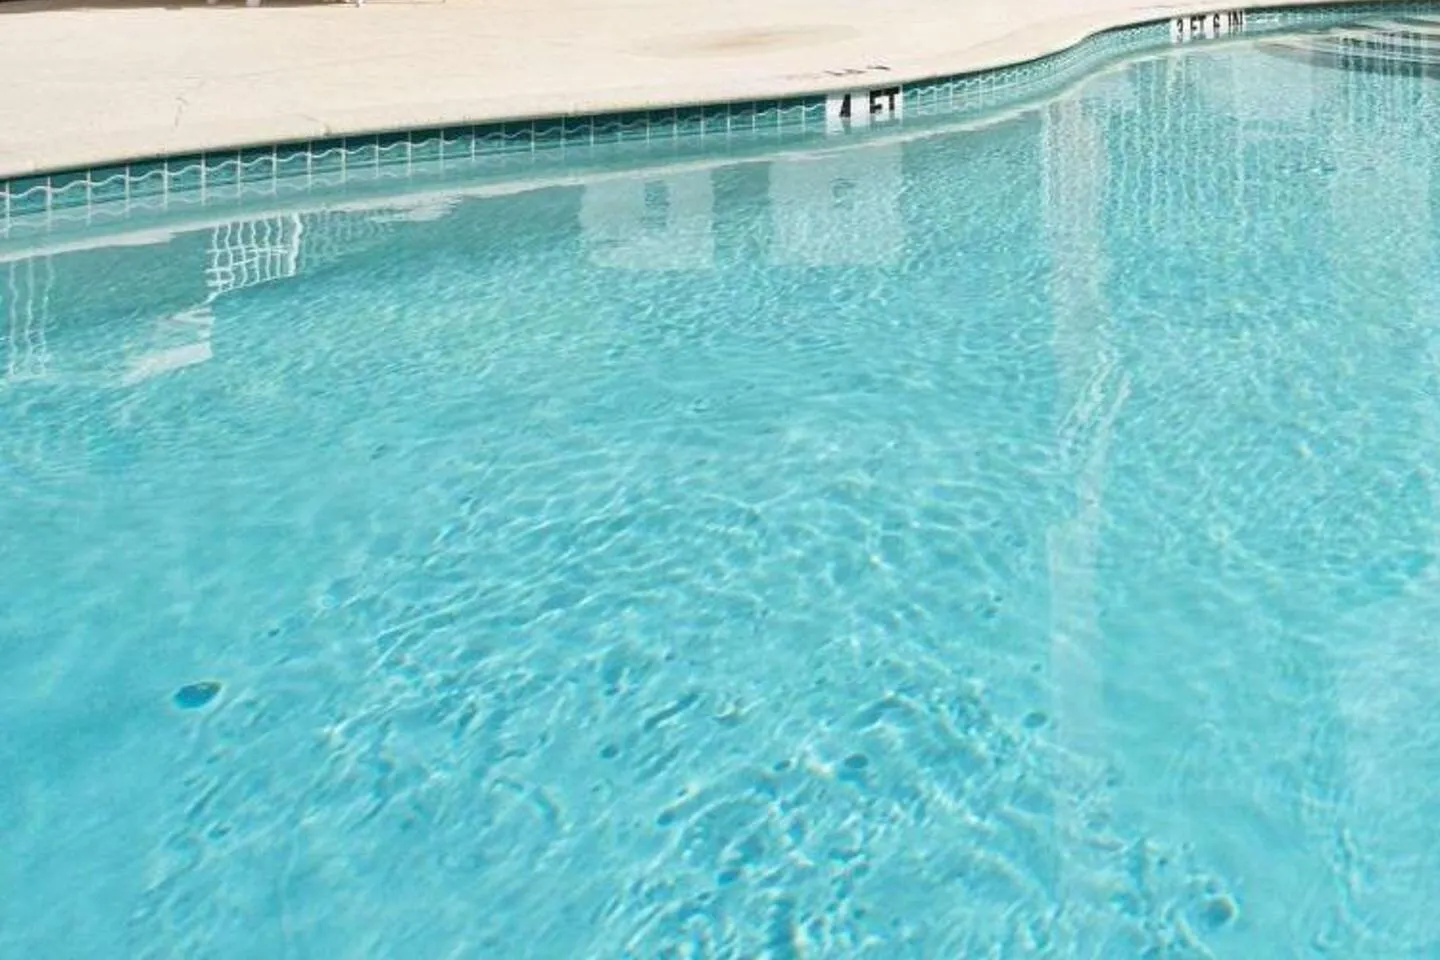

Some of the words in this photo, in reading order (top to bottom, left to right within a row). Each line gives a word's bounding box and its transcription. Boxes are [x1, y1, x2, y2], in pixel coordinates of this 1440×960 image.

[1190, 15, 1207, 31] FT
[1228, 11, 1243, 26] IN
[868, 87, 901, 115] FT
